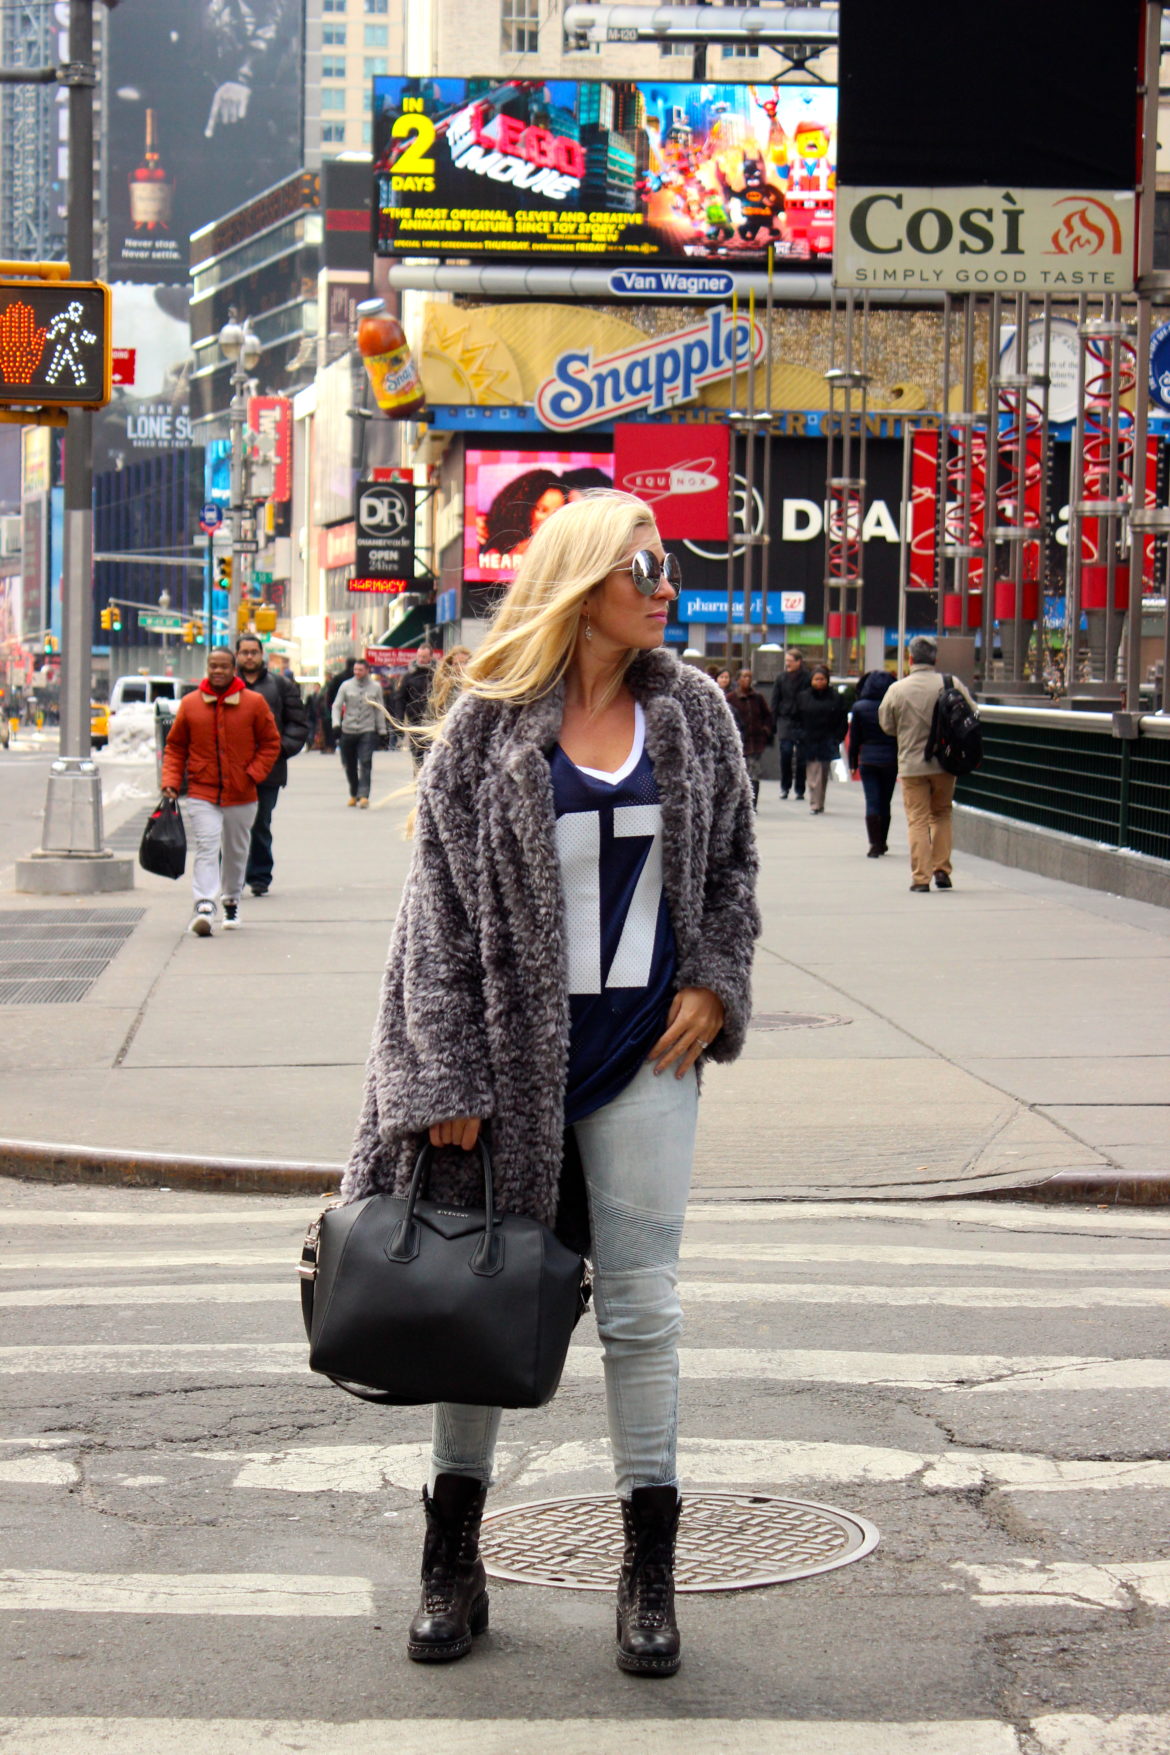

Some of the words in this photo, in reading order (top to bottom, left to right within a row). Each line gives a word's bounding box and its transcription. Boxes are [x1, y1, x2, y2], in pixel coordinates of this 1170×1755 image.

[608, 28, 637, 41] M-120
[402, 97, 424, 112] IN
[390, 113, 436, 174] 2
[469, 103, 586, 179] LEGO
[454, 144, 581, 200] MOVIE
[391, 176, 435, 192] DAYS
[414, 208, 449, 220] MOST
[450, 208, 513, 222] ORIGINAL,
[515, 210, 558, 222] CLEVER
[559, 211, 588, 223] AND
[589, 212, 643, 225] CREATIVE
[849, 191, 1025, 255] Così
[399, 219, 462, 231] ANIMATED
[463, 220, 514, 233] FEATURE
[515, 221, 551, 233] SINCE
[552, 222, 578, 234] TOY
[121, 248, 150, 259] Never
[575, 242, 607, 252] FRIDAY
[621, 273, 656, 290] Van
[660, 273, 728, 294] Wagner
[855, 268, 945, 282] SIMPLY
[956, 269, 1027, 283] GOOD
[1040, 270, 1116, 285] TASTE
[549, 311, 750, 420] Snapple
[127, 415, 172, 439] LONE
[635, 475, 708, 488] EQUINOX
[359, 496, 408, 527] DR
[368, 550, 399, 561] OPEN
[478, 552, 523, 569] HEAR
[369, 560, 398, 571] 24hrs
[544, 803, 664, 995] 17
[436, 1209, 469, 1219] GIVENCHY
